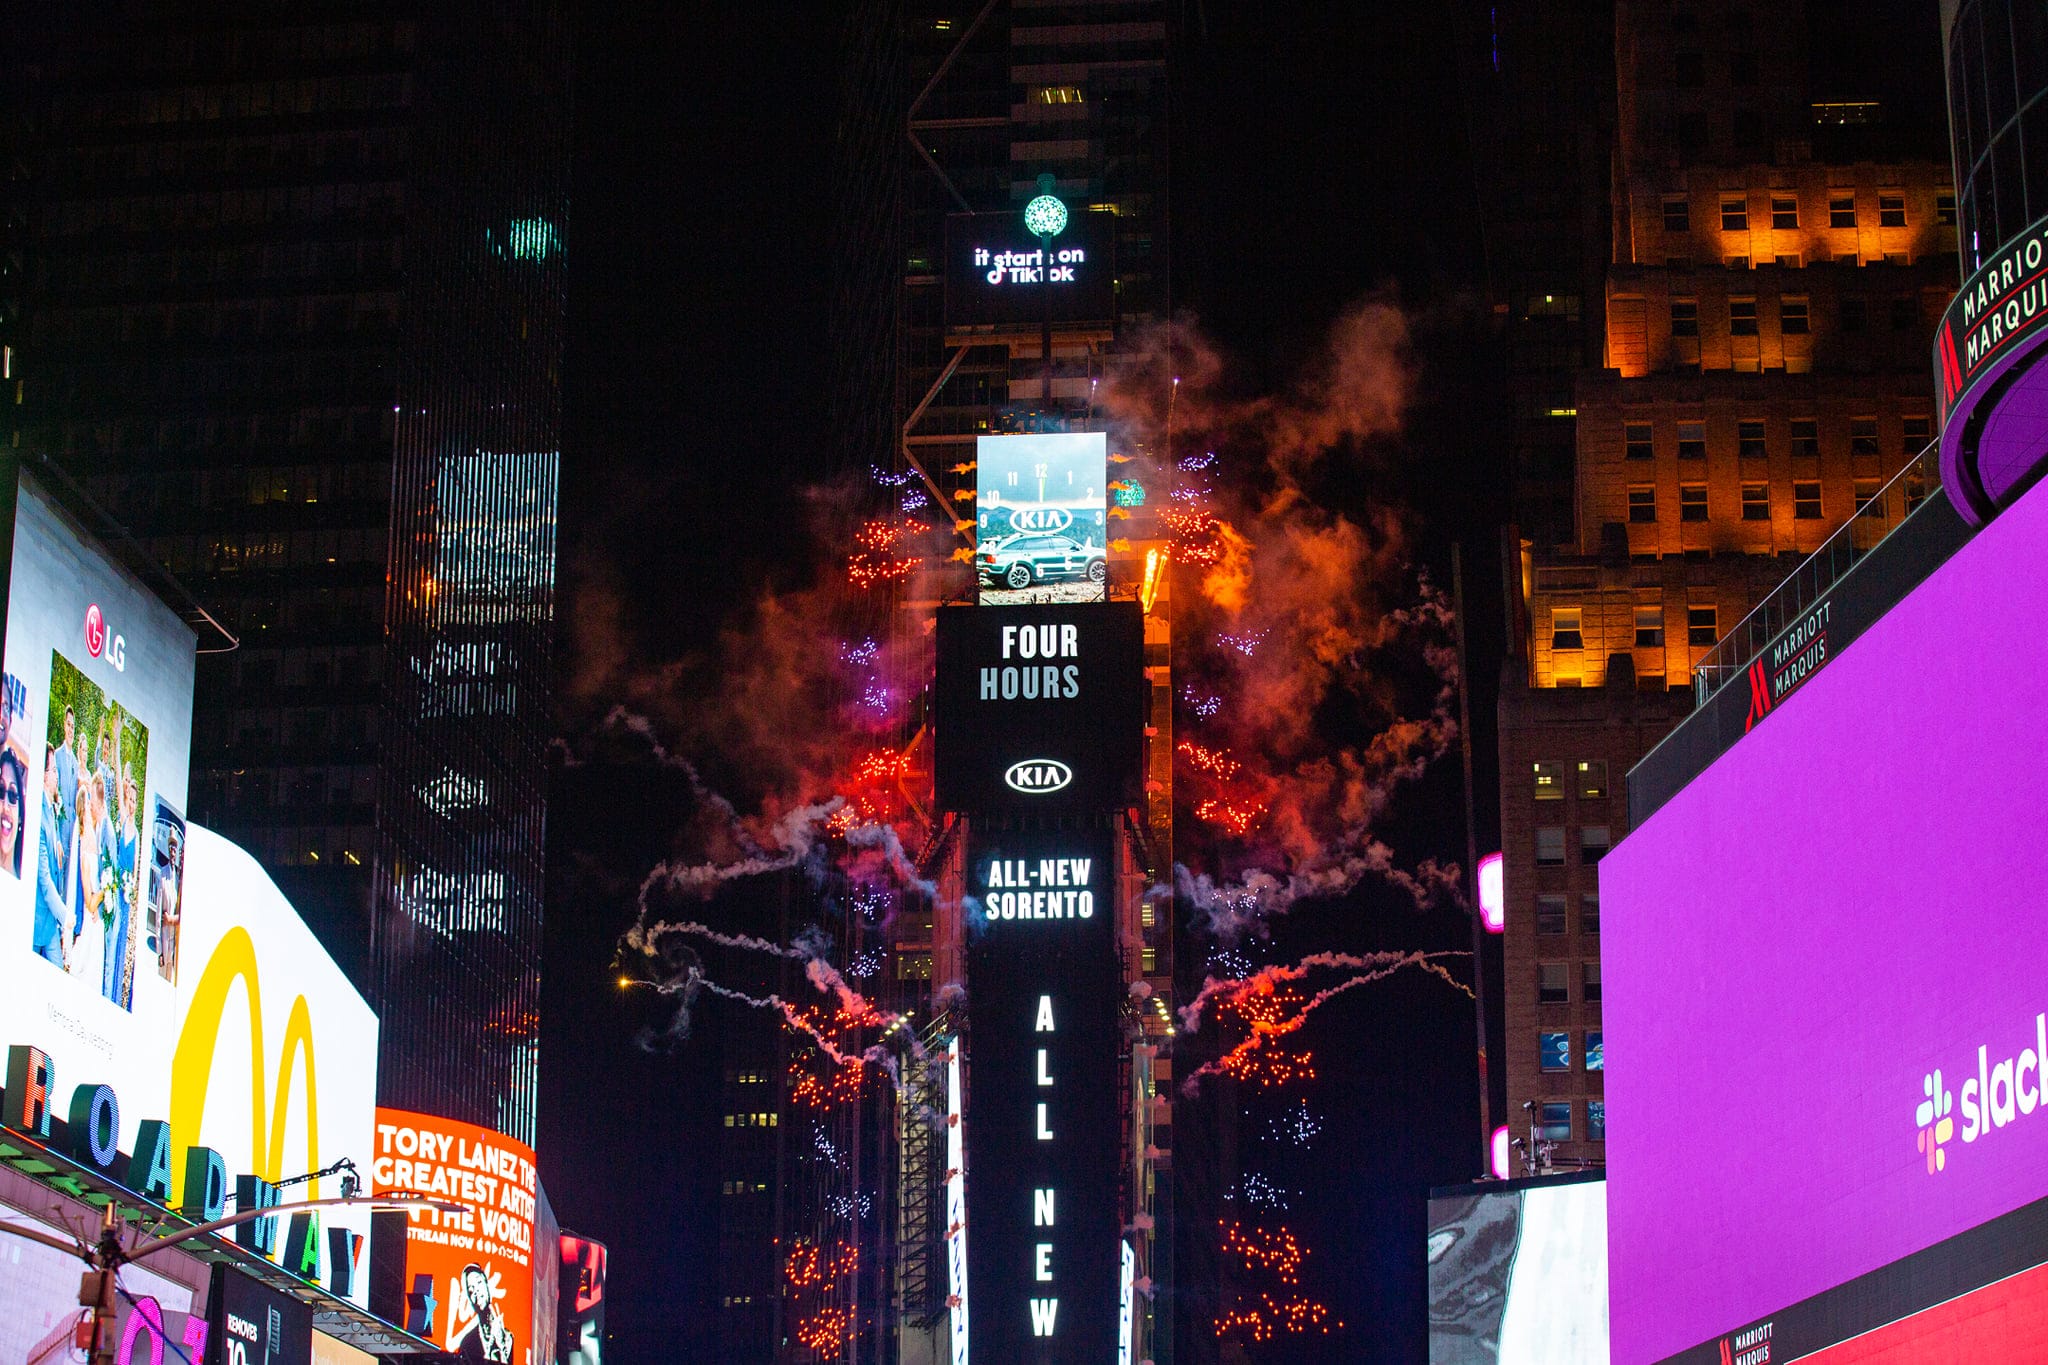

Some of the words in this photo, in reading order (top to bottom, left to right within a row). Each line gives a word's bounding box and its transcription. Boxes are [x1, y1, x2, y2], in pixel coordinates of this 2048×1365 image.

[975, 248, 990, 266] it
[1058, 249, 1084, 263] on
[1963, 231, 2048, 326] MARRIO
[1008, 472, 1018, 486] 11
[1034, 464, 1047, 478] 12
[1067, 471, 1073, 485] 1
[986, 491, 1000, 503] 10
[980, 514, 988, 528] 9
[1021, 511, 1063, 528] KIA
[1096, 511, 1103, 526] 3
[104, 624, 126, 672] LG
[1002, 624, 1078, 658] FOUR
[1774, 601, 1830, 668] MARRIOTT
[980, 665, 1079, 700] HOURS
[1775, 639, 1825, 698] MARQUIS
[1017, 767, 1061, 786] KIA
[988, 858, 1091, 887] ALL-NEW
[986, 891, 1093, 920] SORENTO
[1035, 995, 1055, 1140] ALL
[378, 1124, 454, 1162] TORY
[459, 1138, 518, 1182] LANEZ
[373, 1157, 498, 1205] GREATEST
[450, 1234, 474, 1250] NOW
[1030, 1189, 1058, 1337] NEW
[227, 1313, 258, 1342] REMOVES
[1735, 1322, 1773, 1351] MARRIOTT
